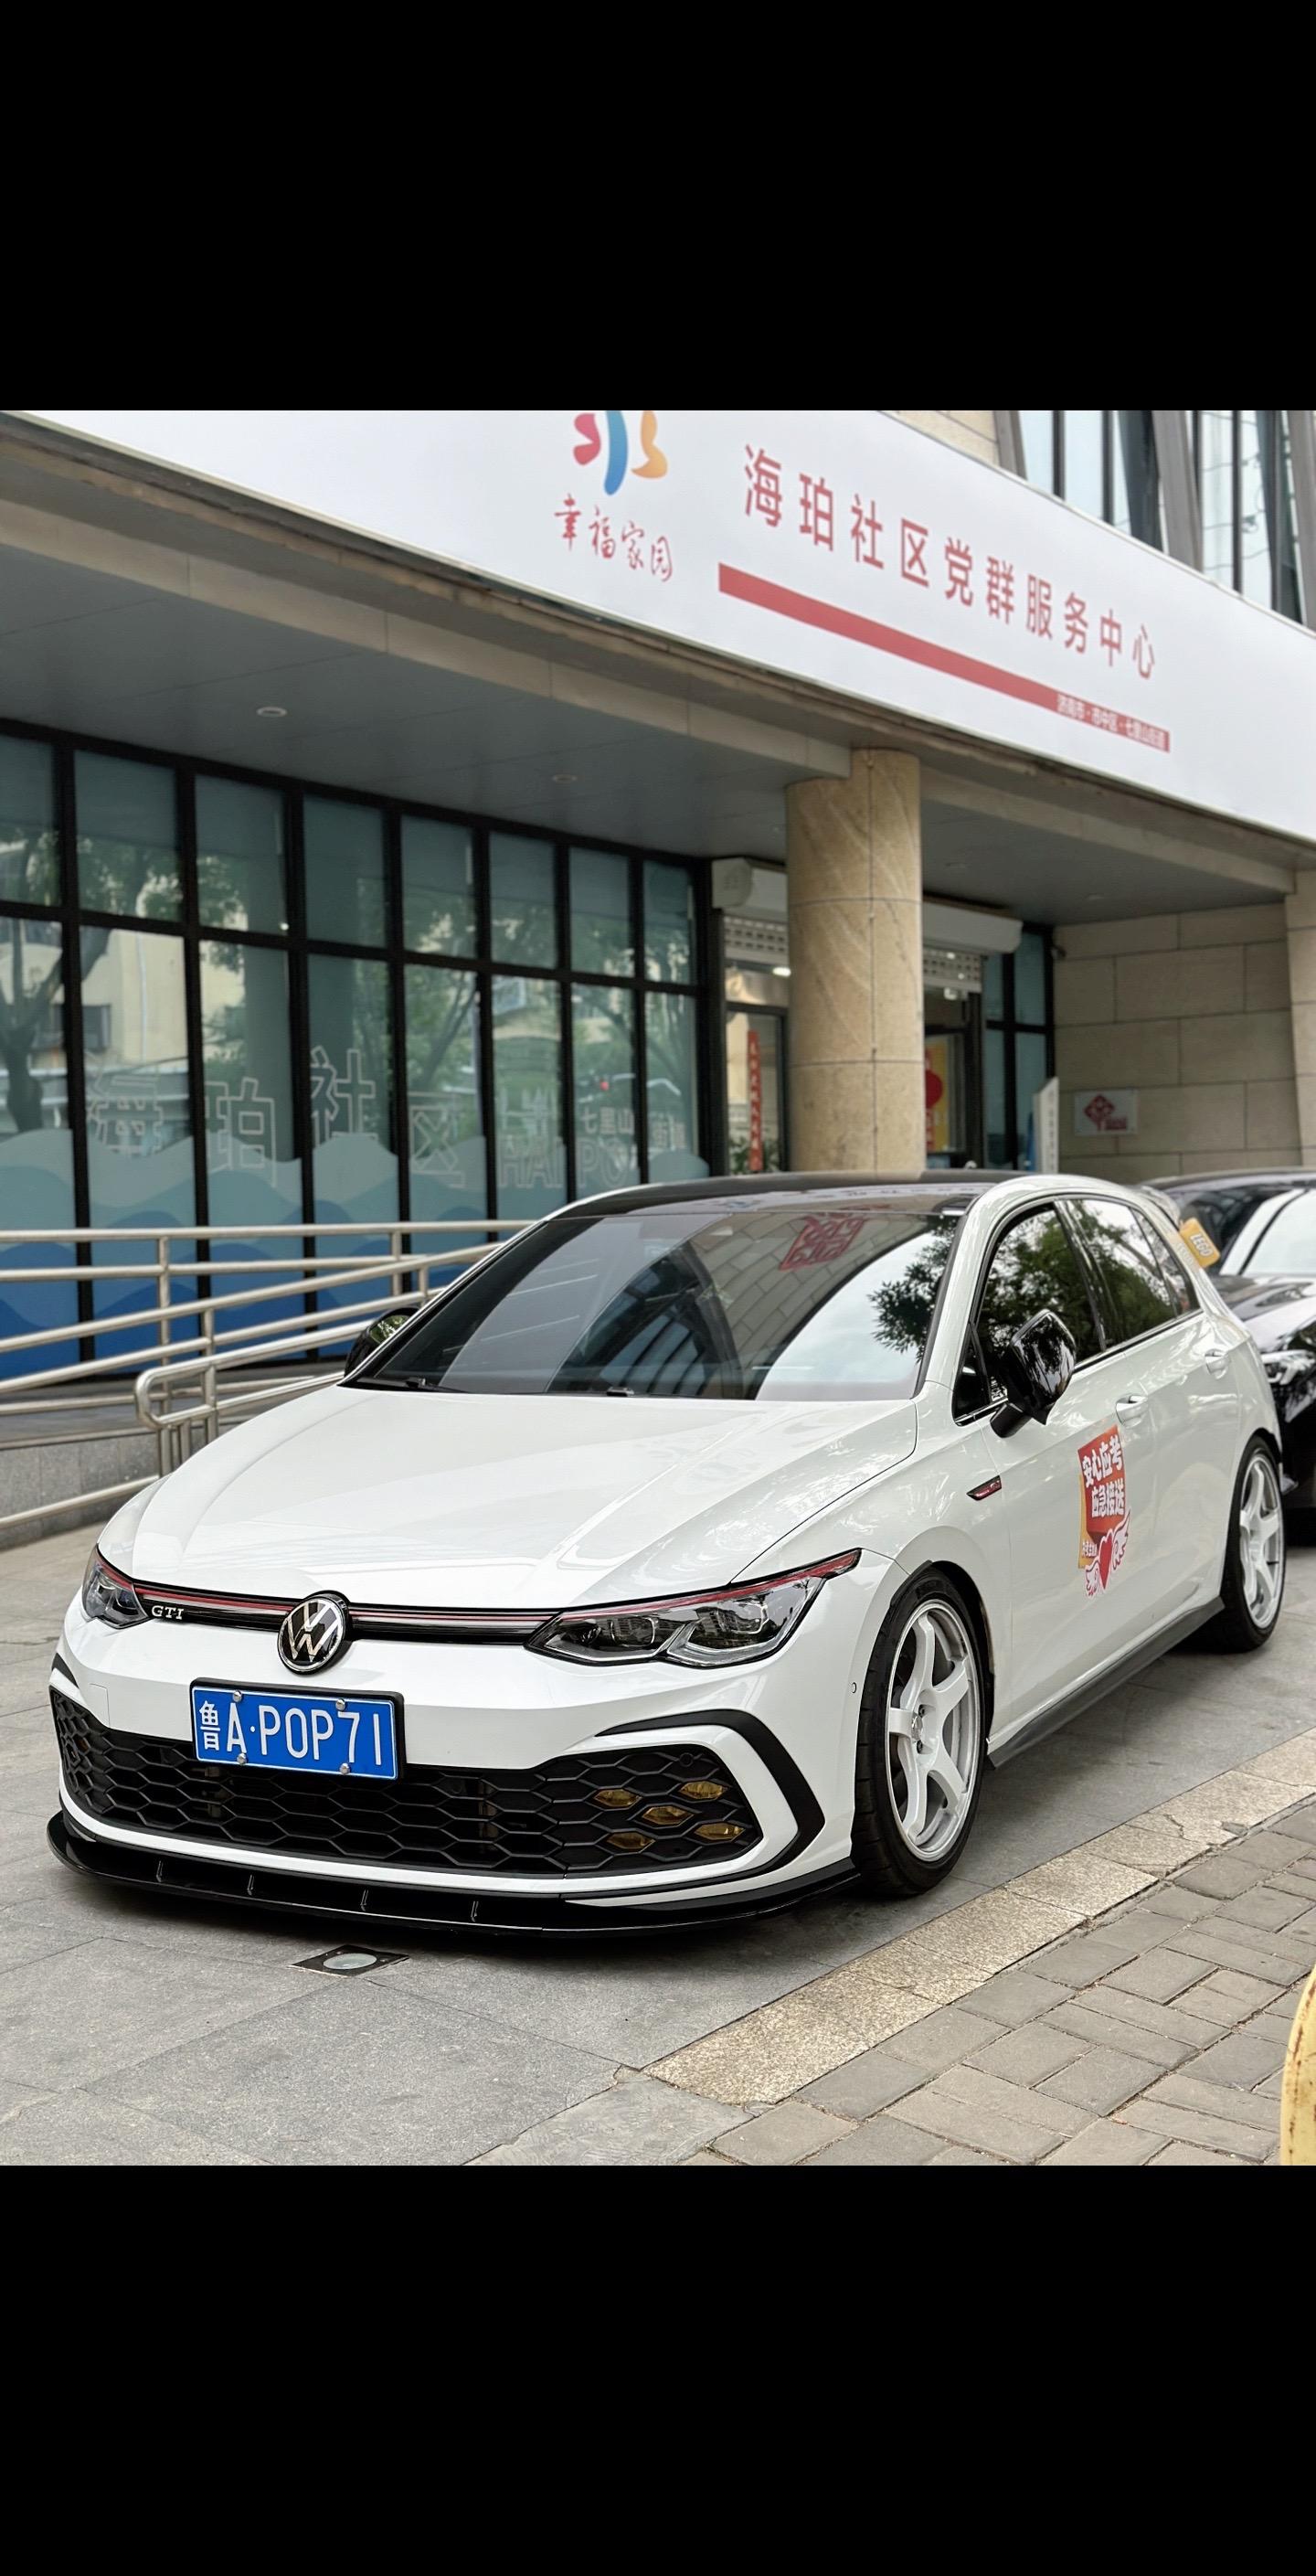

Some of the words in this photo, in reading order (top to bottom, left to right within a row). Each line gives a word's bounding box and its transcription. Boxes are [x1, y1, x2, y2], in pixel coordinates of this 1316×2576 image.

[554, 493, 674, 582] 幸福家园
[744, 444, 1155, 679] 海珀社区党群服务中心
[1190, 1233, 1215, 1257] LEGO
[1082, 1434, 1123, 1488] 安心应考
[1091, 1477, 1125, 1518] 应急接送
[151, 1604, 185, 1621] GTI
